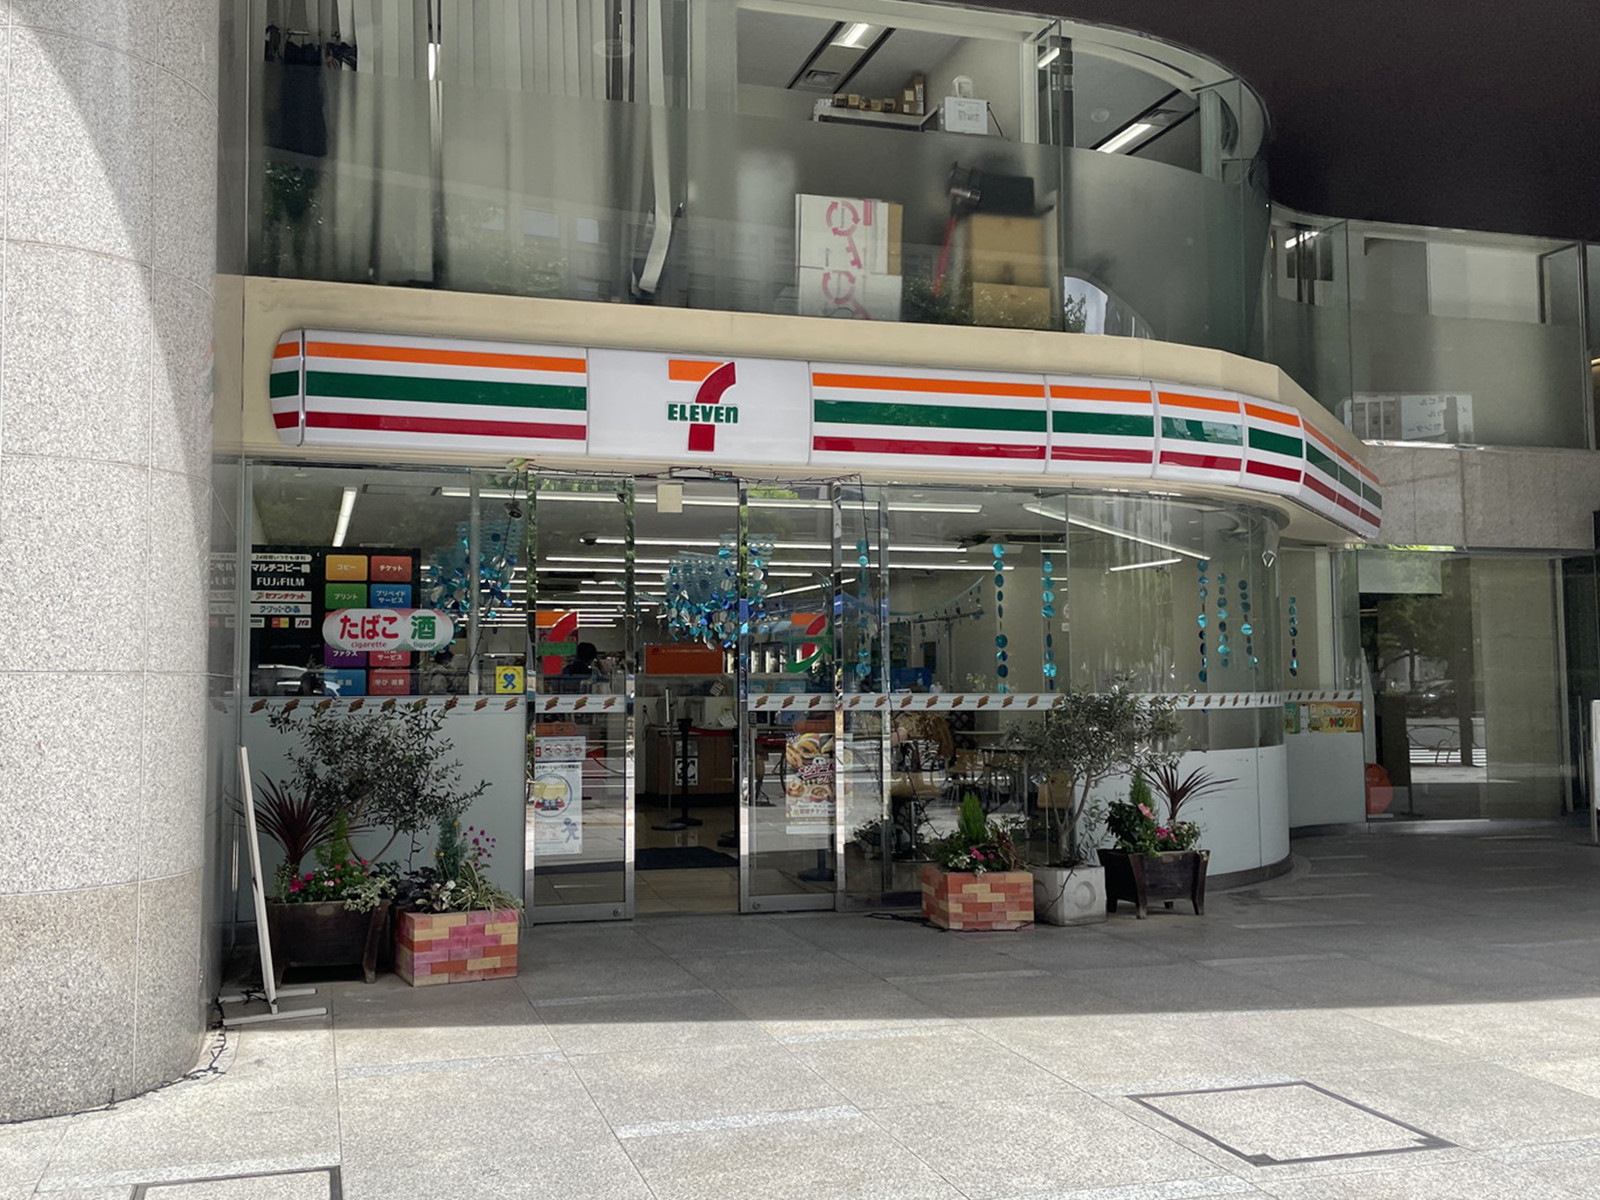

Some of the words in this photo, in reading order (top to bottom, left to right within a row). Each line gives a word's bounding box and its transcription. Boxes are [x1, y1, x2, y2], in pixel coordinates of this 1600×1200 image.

[379, 564, 403, 572] チケット
[334, 593, 358, 601] プリント
[340, 615, 399, 640] たばこ
[411, 615, 437, 640] 酒
[350, 641, 388, 649] cigarette
[413, 641, 437, 649] liquor
